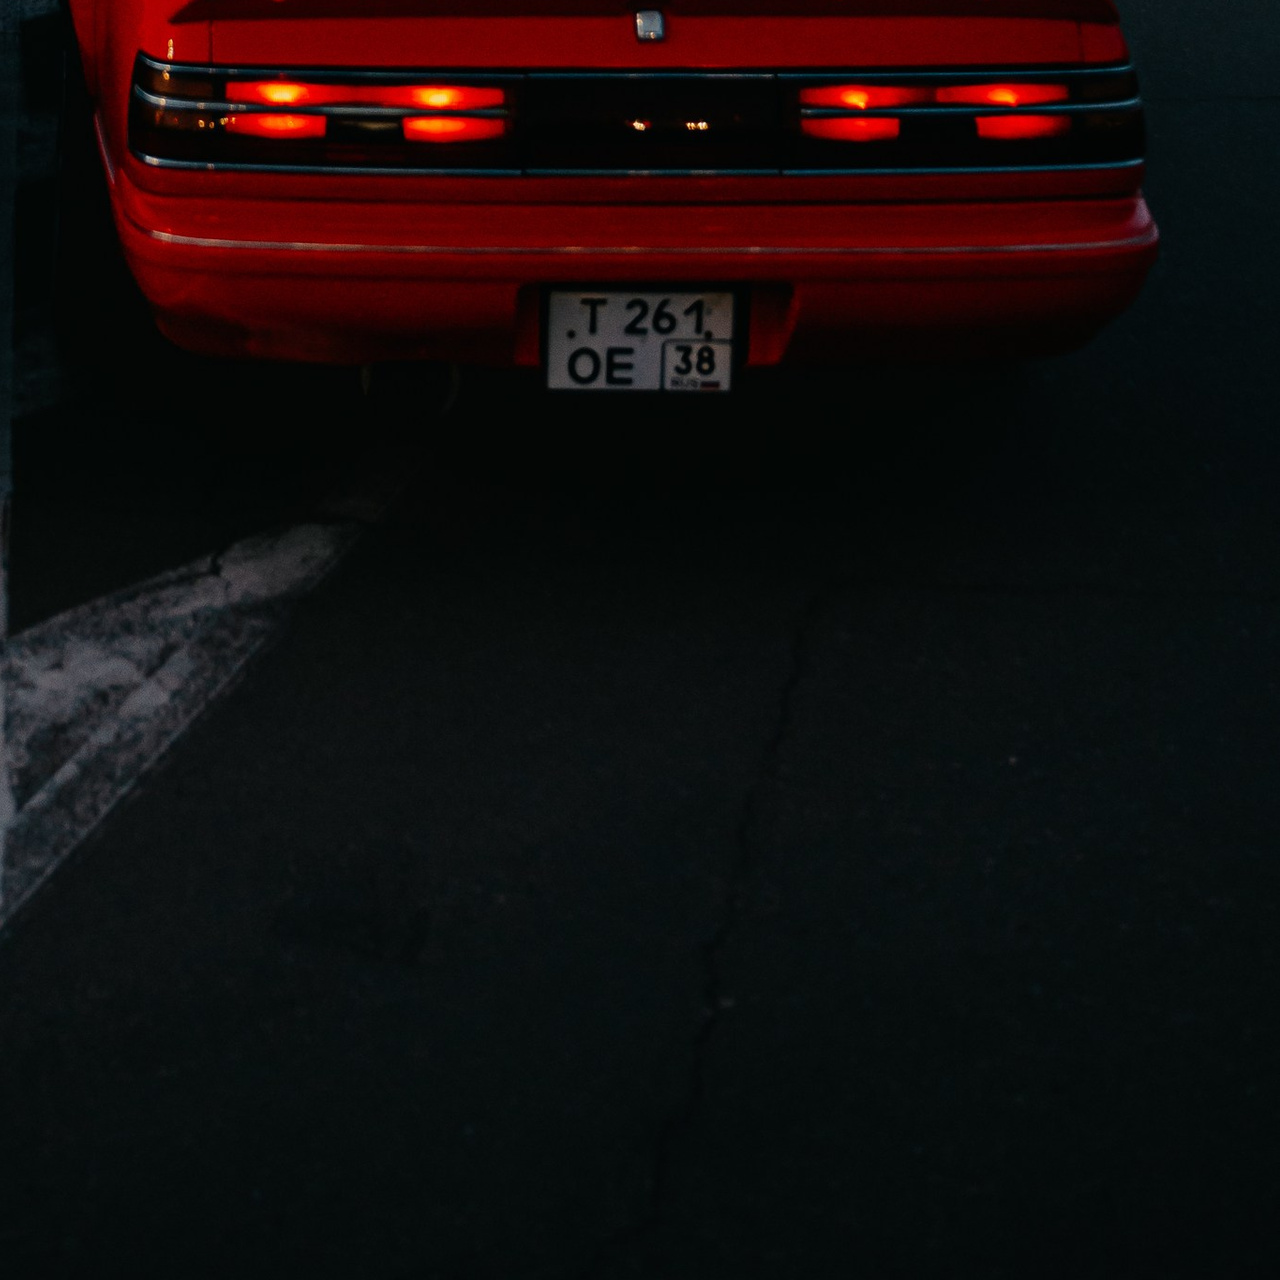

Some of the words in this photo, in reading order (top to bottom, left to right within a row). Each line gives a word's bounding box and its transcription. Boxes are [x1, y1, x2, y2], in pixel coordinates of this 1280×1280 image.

[580, 297, 608, 335] Т
[624, 298, 704, 335] 261
[567, 346, 635, 385] ОЕ
[674, 344, 716, 376] 38
